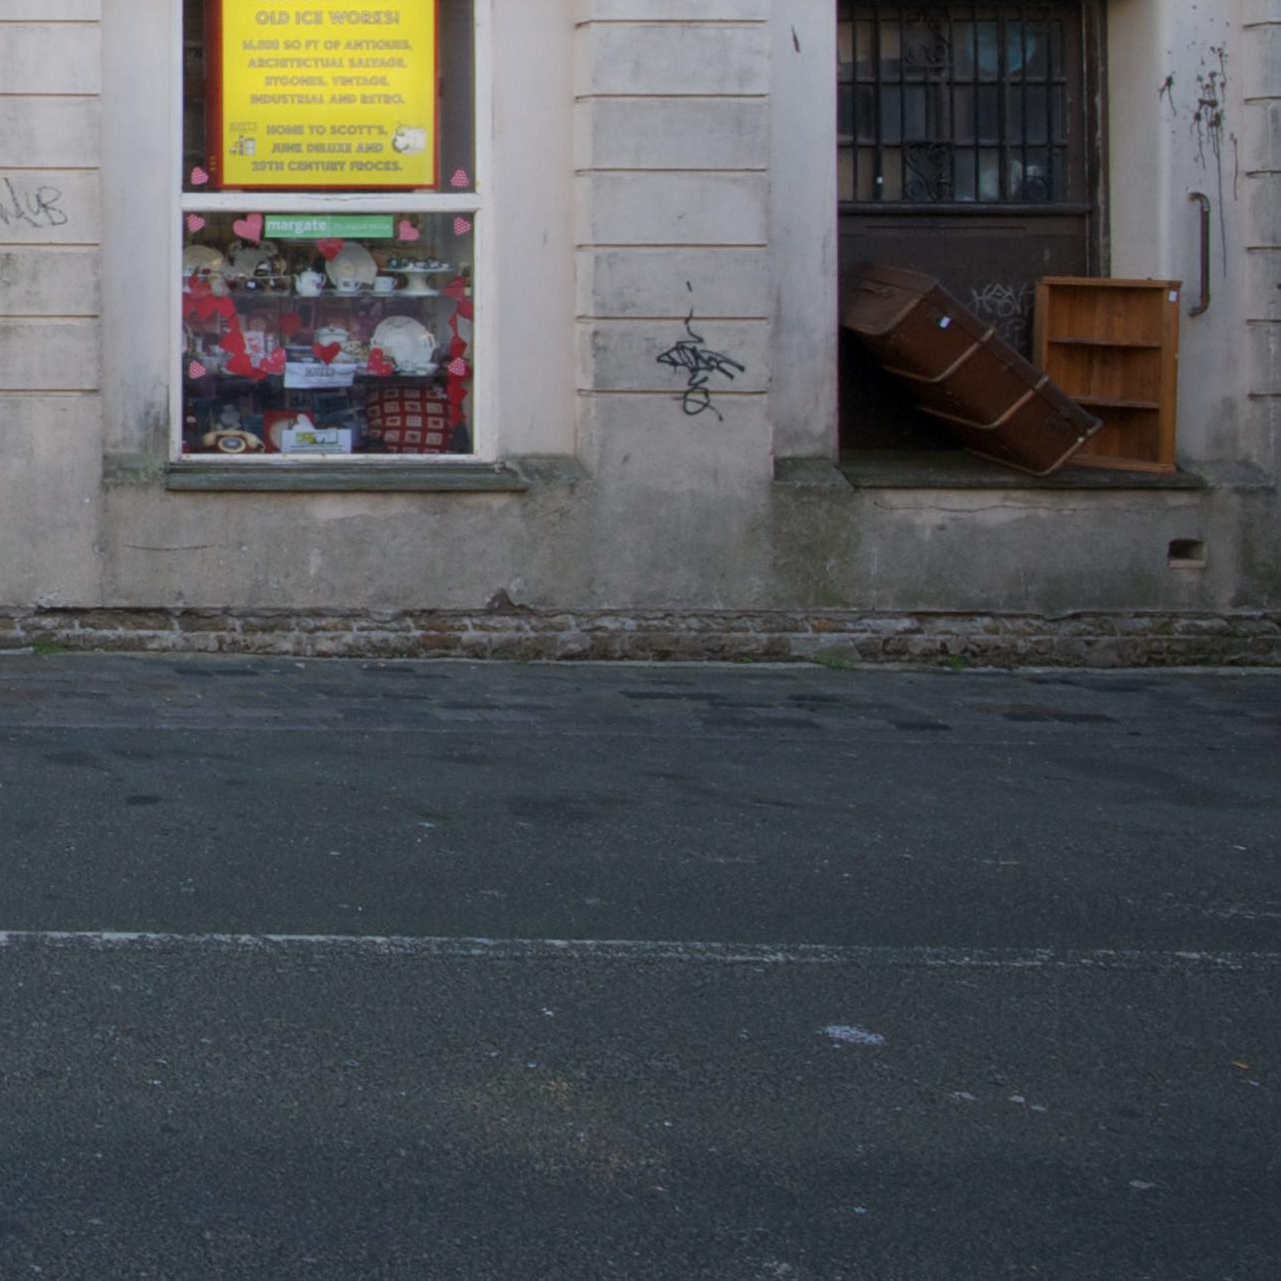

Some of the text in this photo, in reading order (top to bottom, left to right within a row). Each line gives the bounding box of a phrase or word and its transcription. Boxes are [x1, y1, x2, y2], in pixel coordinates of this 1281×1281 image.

[255, 10, 400, 25] OLD ICE WORKS!
[305, 39, 319, 51] FT
[323, 39, 341, 51] OF
[249, 93, 325, 105] INDUSTRIAL
[329, 93, 357, 105] AND
[267, 124, 305, 136] HOME
[309, 124, 326, 136] TO
[271, 142, 383, 154] JUNK DELUXE AND
[287, 160, 346, 172] CENTURY
[267, 219, 327, 235] margate
